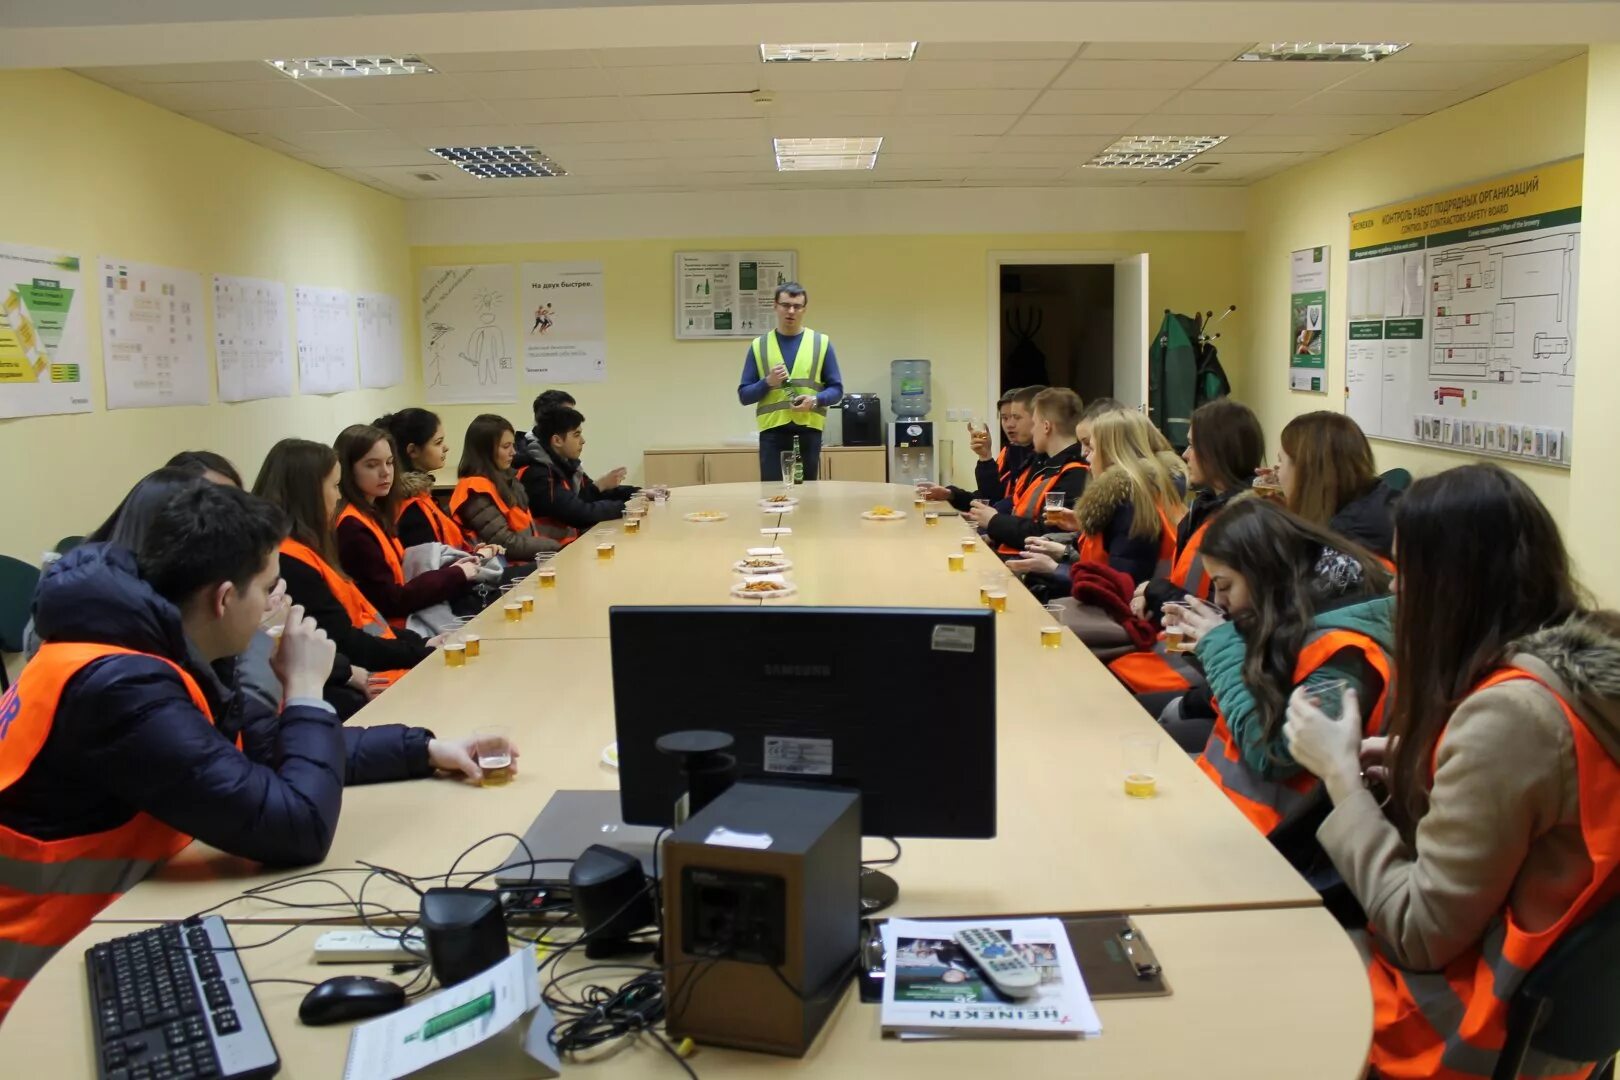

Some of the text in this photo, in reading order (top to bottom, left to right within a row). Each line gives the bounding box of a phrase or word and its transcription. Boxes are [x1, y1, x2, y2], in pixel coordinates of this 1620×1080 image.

[1382, 175, 1540, 225] КОНТРОЛЬ РАБОТ ПОДРЯДНЫХ ОРГАНИЗАЦИЙ
[1401, 204, 1509, 233] CONTROL OF CONTRACTORS SAFETY BOARD
[543, 282, 559, 290] двух
[560, 281, 593, 289] быстрее.
[763, 664, 831, 676] SAMSUNG
[930, 1010, 1059, 1019] HEINEKEN
